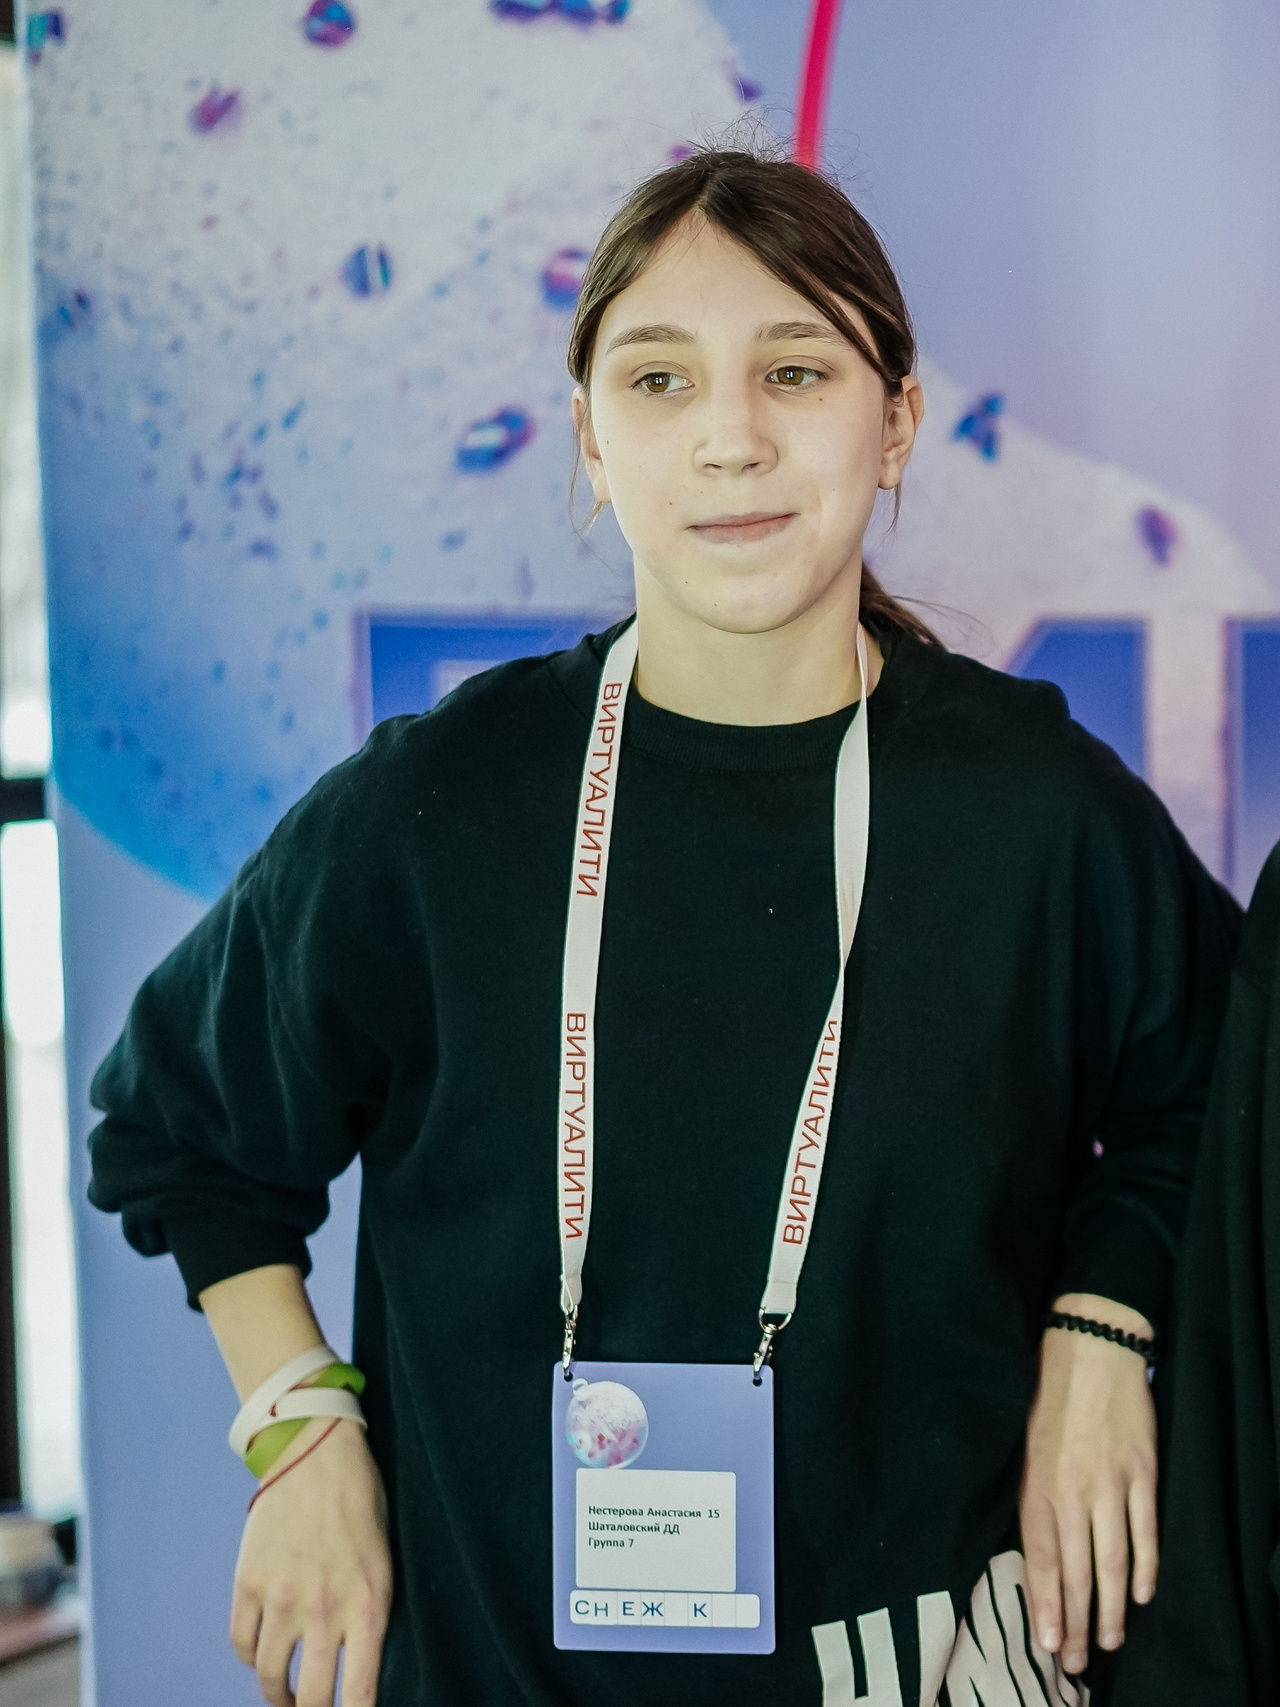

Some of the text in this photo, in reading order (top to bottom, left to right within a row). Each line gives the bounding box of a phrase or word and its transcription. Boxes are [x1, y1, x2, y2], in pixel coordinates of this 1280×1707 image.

[577, 681, 624, 897] ВИРТУАЛИТИ
[565, 1011, 587, 1240] ВИРТУАЛИТИ
[782, 1020, 837, 1245] ВИРТУАЛИТИ
[588, 1505, 720, 1518] Нестерова Анастасия 15
[588, 1521, 681, 1535] Шаталовский ДД
[588, 1537, 634, 1549] Группа 7
